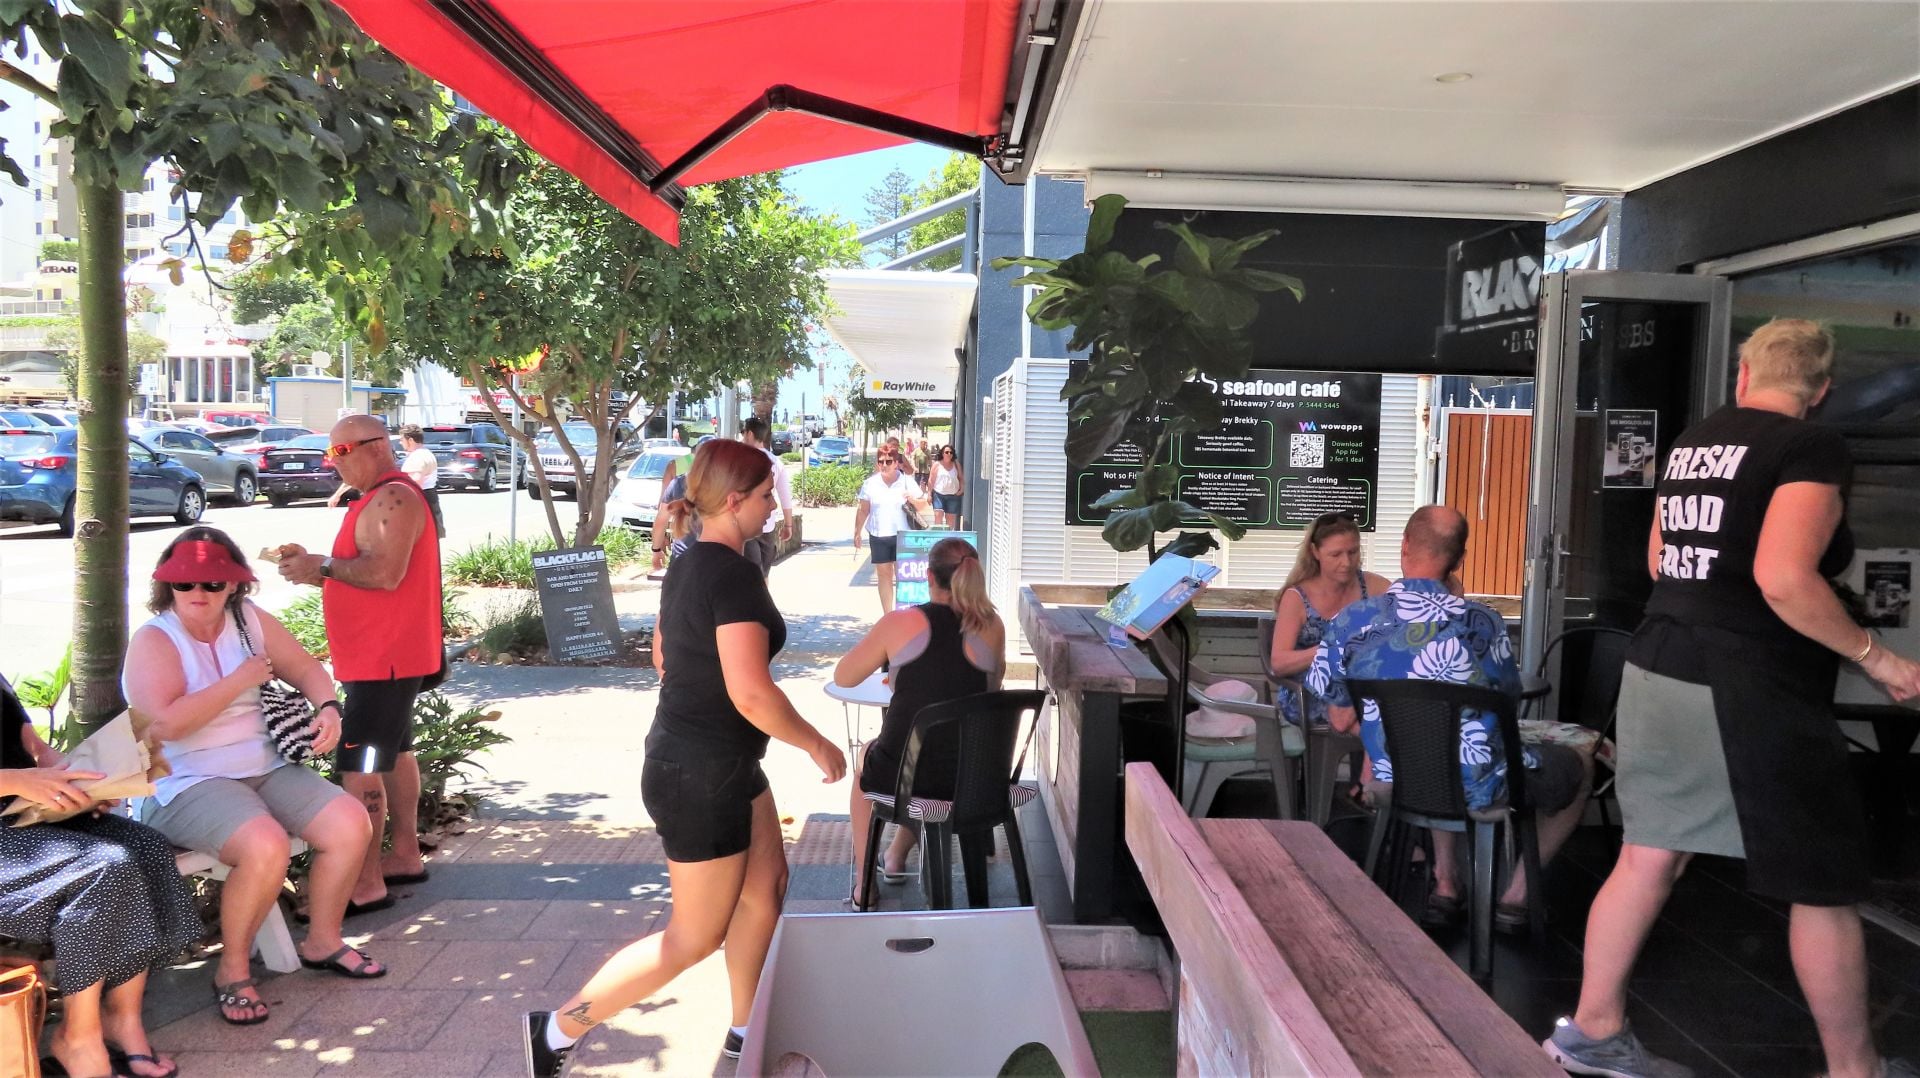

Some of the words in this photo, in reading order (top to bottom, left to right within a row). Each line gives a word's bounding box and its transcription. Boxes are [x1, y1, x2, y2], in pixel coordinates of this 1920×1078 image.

[1222, 379, 1297, 396] seafood
[1300, 380, 1342, 397] café
[1230, 399, 1268, 409] Takeaway
[1270, 400, 1275, 408] 7
[1276, 400, 1295, 409] days
[1234, 416, 1259, 426] Brekky
[1320, 423, 1363, 432] wowapps
[1335, 448, 1348, 456] App
[1663, 444, 1749, 480] FRESH
[1198, 472, 1222, 480] Notice
[1223, 472, 1232, 480] of
[1307, 475, 1338, 485] Catering
[1659, 494, 1724, 533] FOOD
[533, 550, 597, 567] BLACKFLAG
